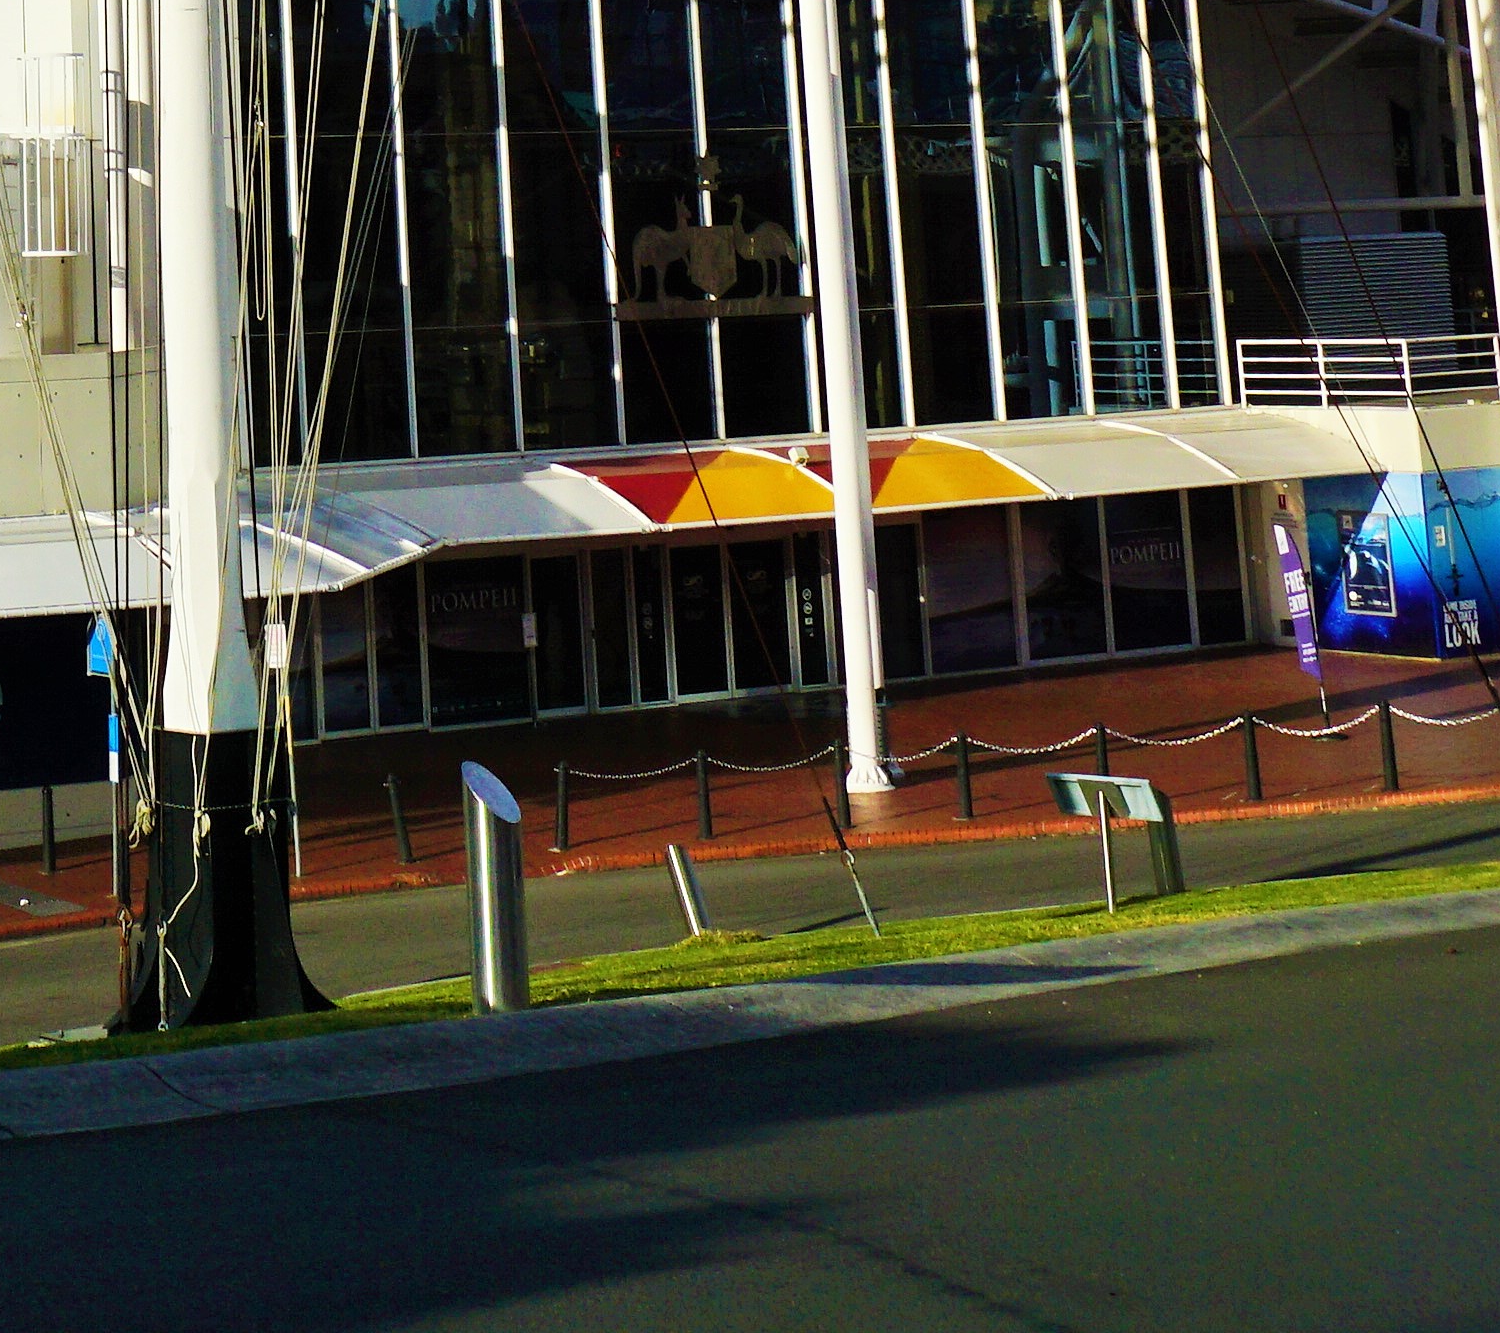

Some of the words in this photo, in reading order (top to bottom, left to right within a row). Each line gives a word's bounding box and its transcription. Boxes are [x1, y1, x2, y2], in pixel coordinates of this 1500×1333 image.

[1284, 568, 1306, 594] FREE
[430, 587, 517, 613] POMPEII
[1445, 621, 1481, 648] LOOK
